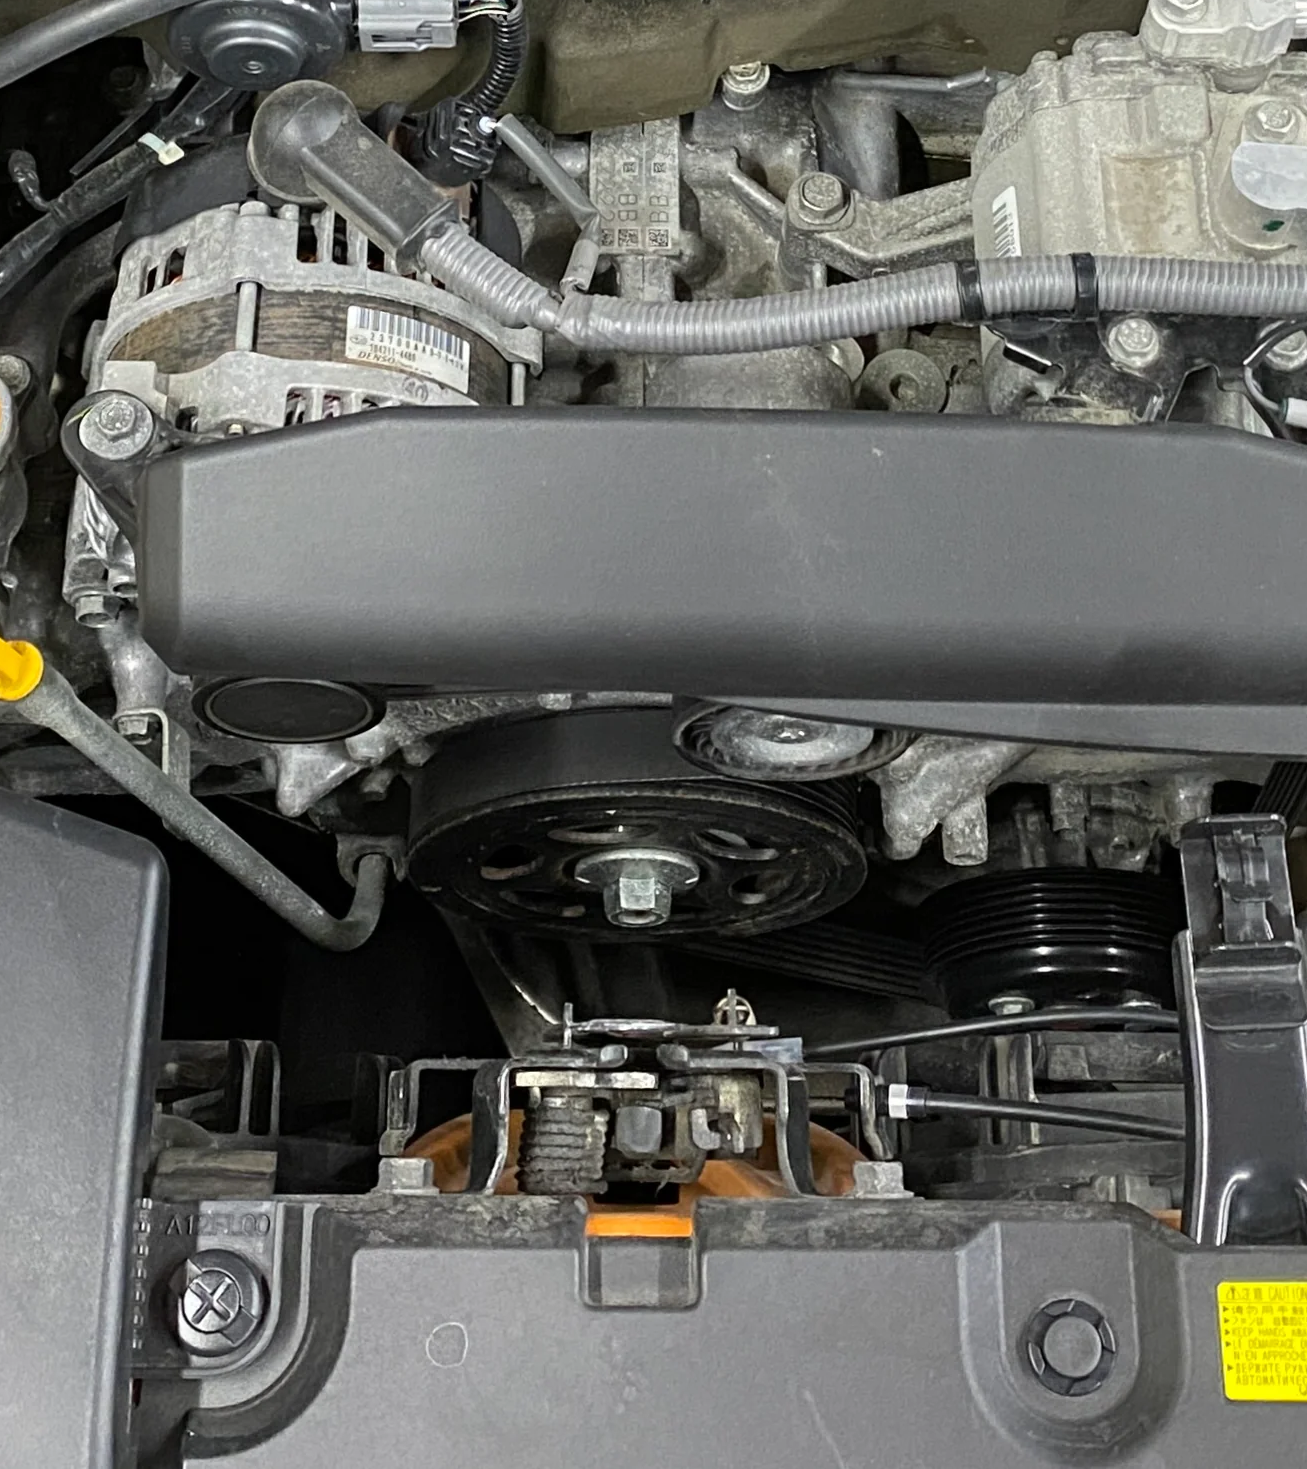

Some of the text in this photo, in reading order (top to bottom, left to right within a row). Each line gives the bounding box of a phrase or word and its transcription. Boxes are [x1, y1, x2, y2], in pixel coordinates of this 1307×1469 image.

[358, 351, 395, 364] DENSO
[1232, 1328, 1253, 1338] KEEP
[1258, 1328, 1286, 1338] HANDS
[1232, 1339, 1243, 1349] LE
[1236, 1363, 1280, 1374] ДЕРЖИТЕ
